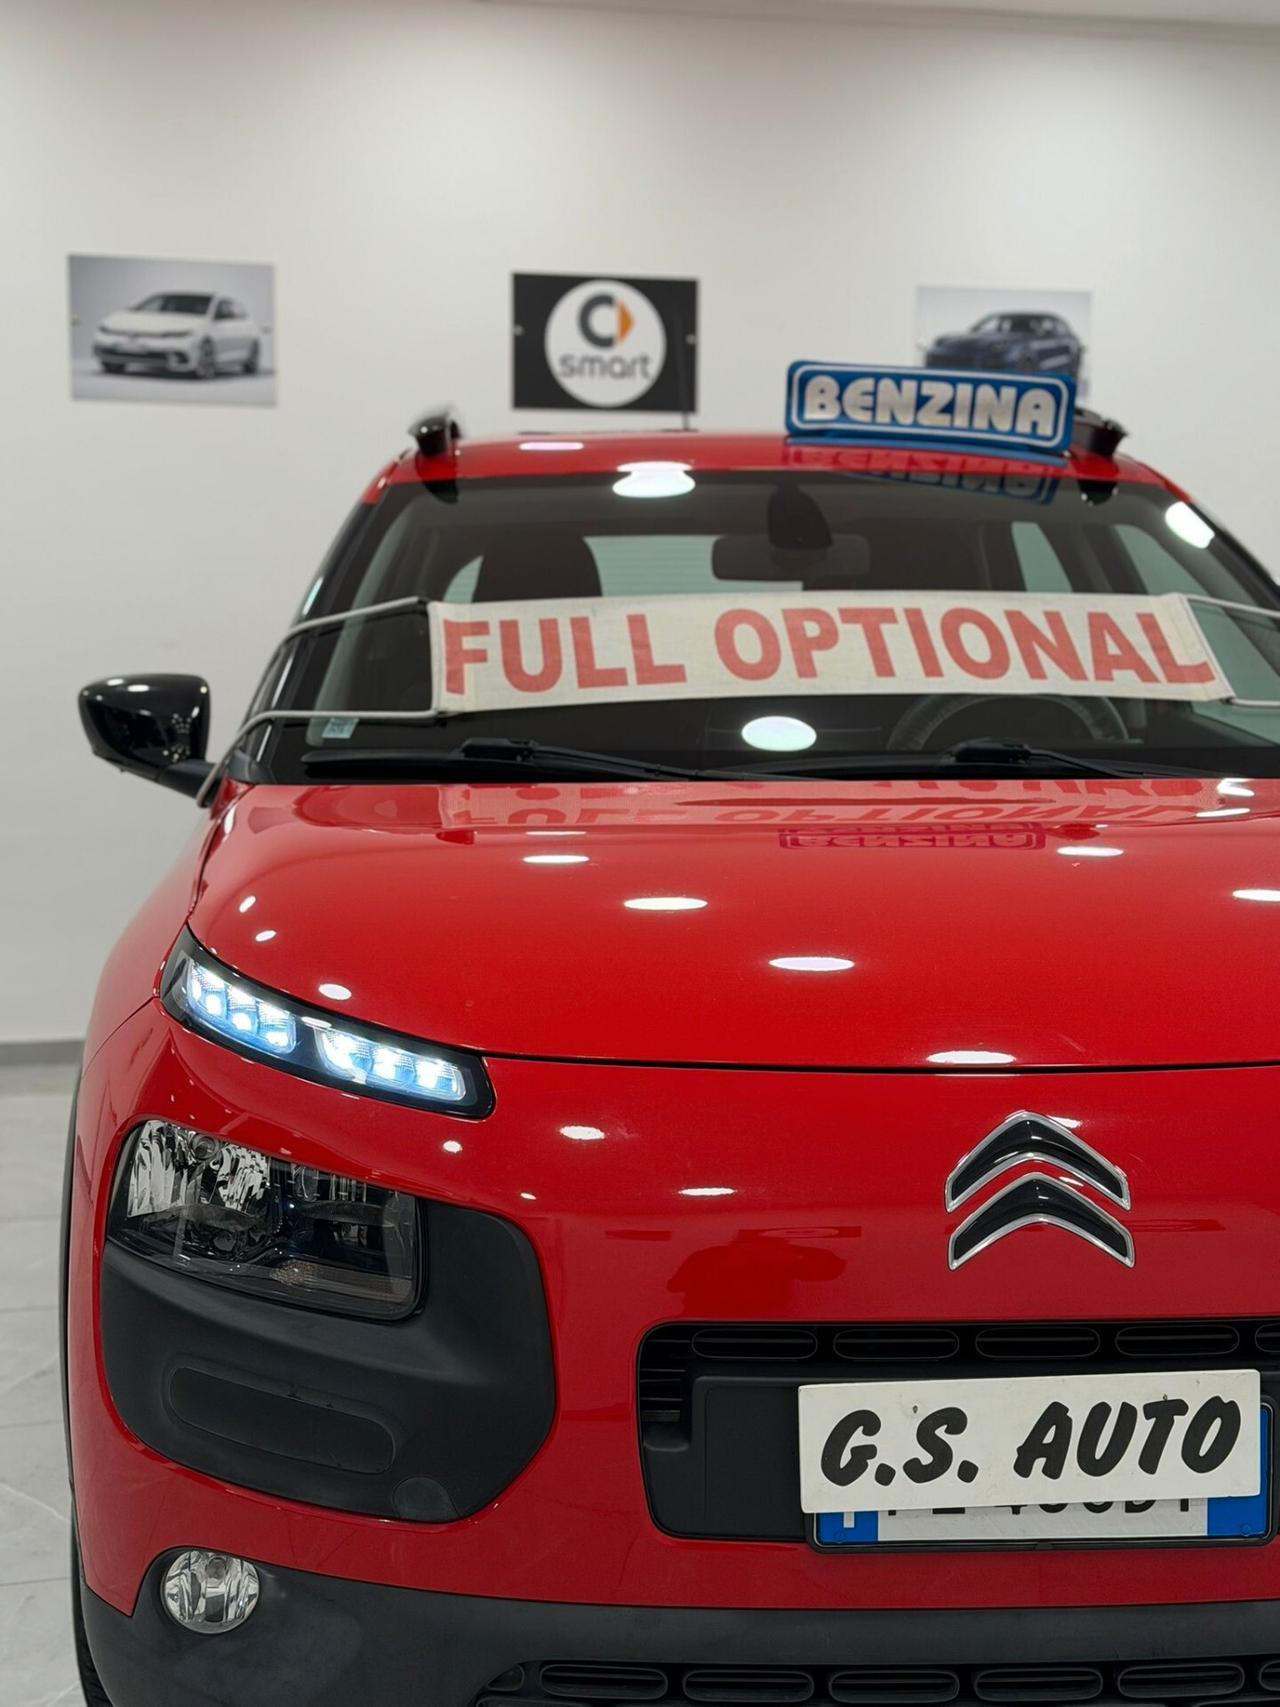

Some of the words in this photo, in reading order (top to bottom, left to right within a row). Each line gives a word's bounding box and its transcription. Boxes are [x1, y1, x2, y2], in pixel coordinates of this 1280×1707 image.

[559, 353, 651, 380] smart
[802, 374, 1057, 438] BENZINA
[443, 613, 688, 696] FULL
[713, 606, 1216, 685] OPTIONAL
[820, 1406, 979, 1487] G.S.
[1013, 1395, 1242, 1481] AUTO
